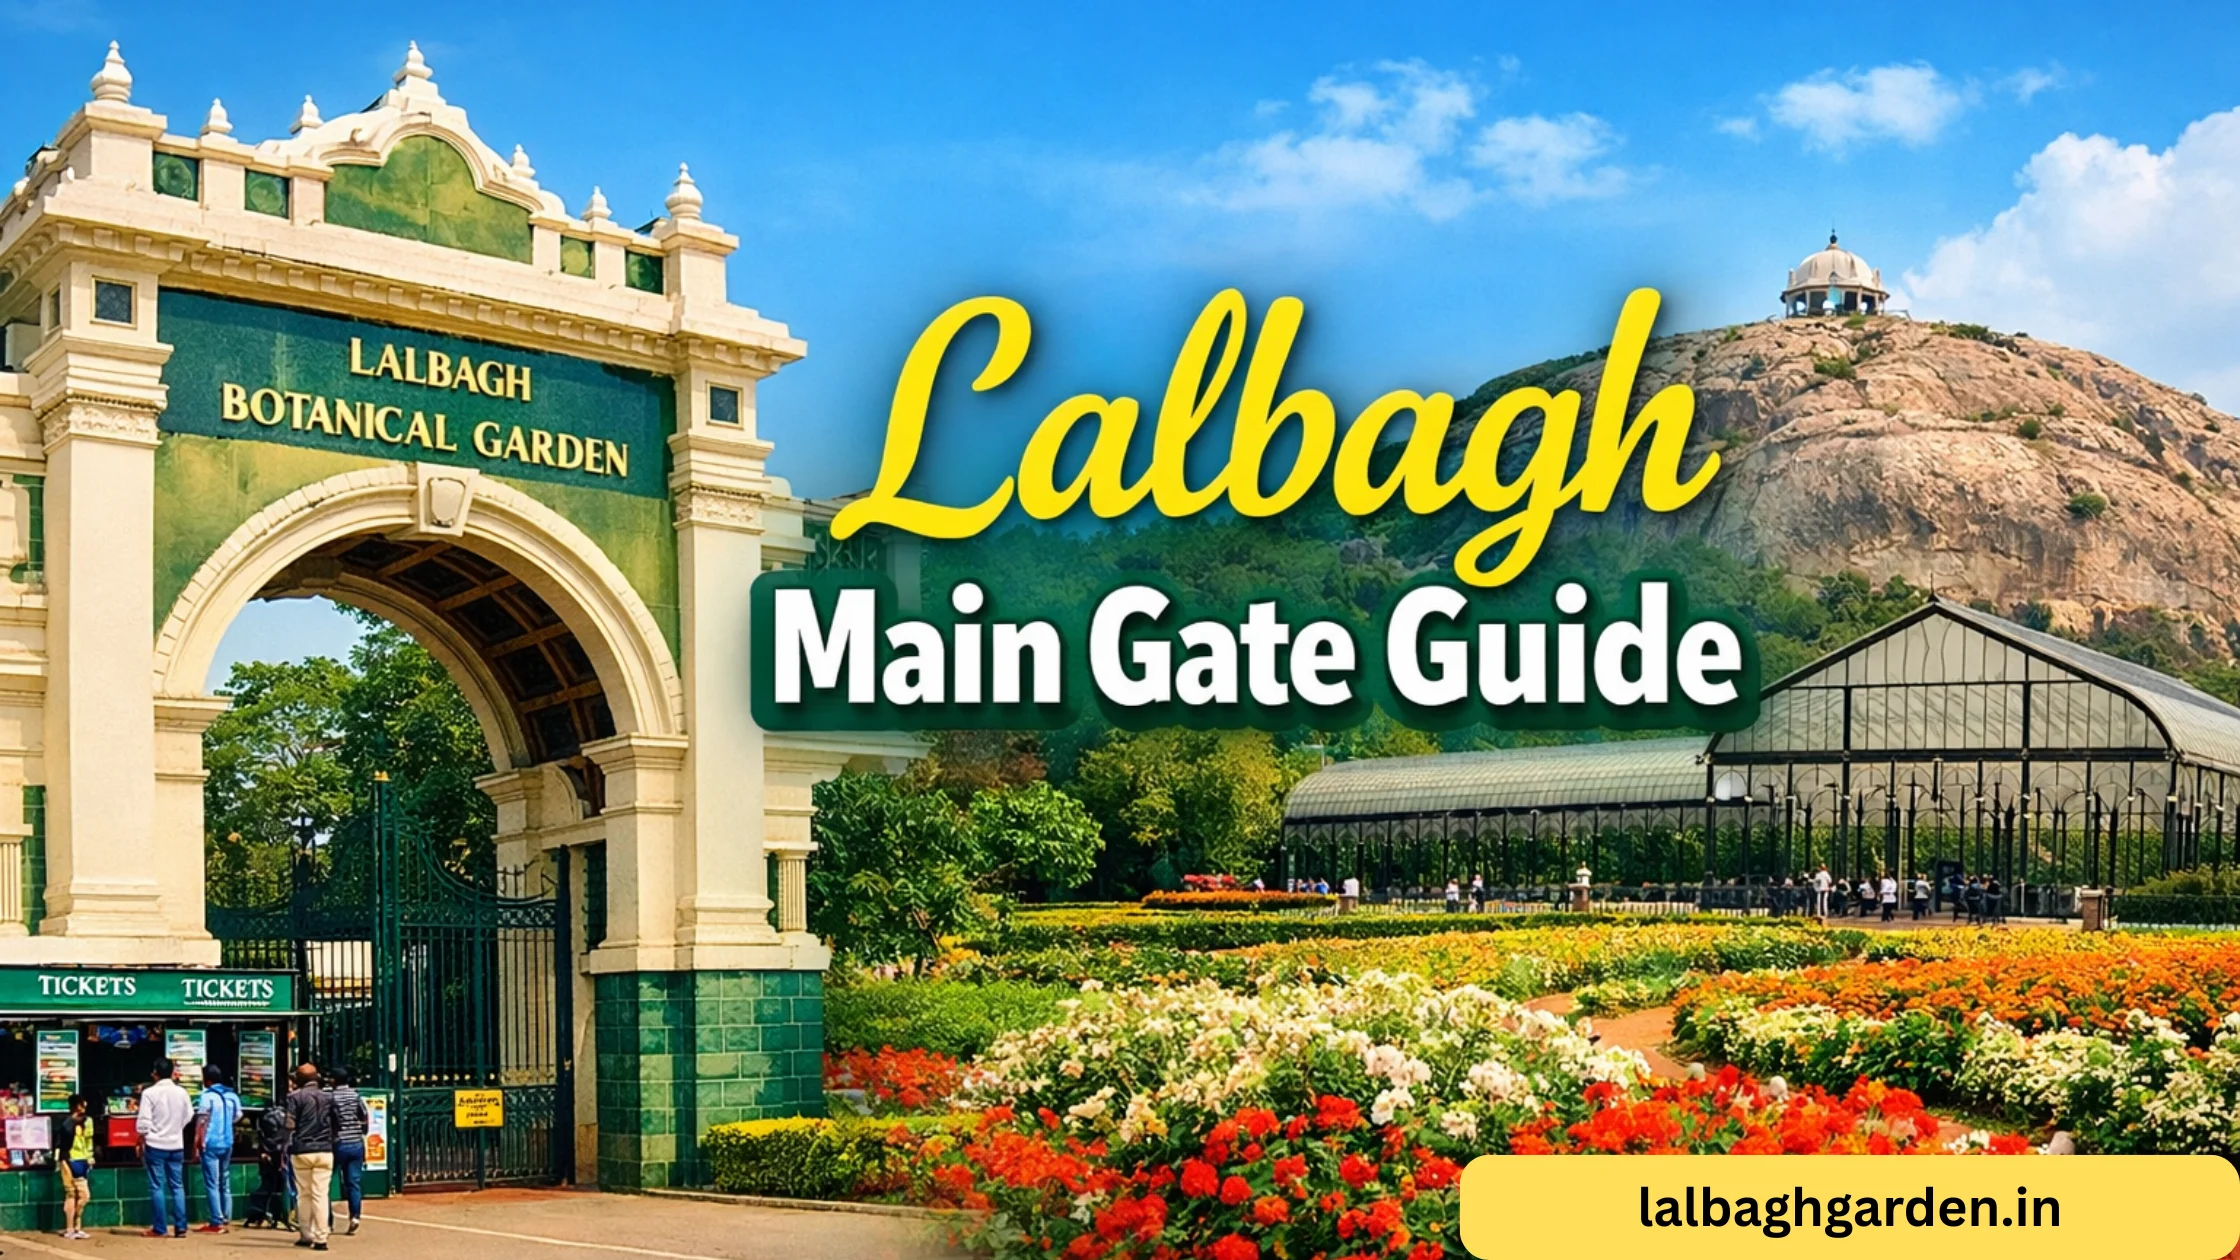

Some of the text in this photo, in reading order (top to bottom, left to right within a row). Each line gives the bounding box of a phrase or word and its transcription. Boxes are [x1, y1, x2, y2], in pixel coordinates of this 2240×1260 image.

[349, 337, 532, 401] LALBAGH
[221, 382, 628, 477] BOTANICAL GARDEN
[38, 975, 274, 998] TICKETS TICKETS
